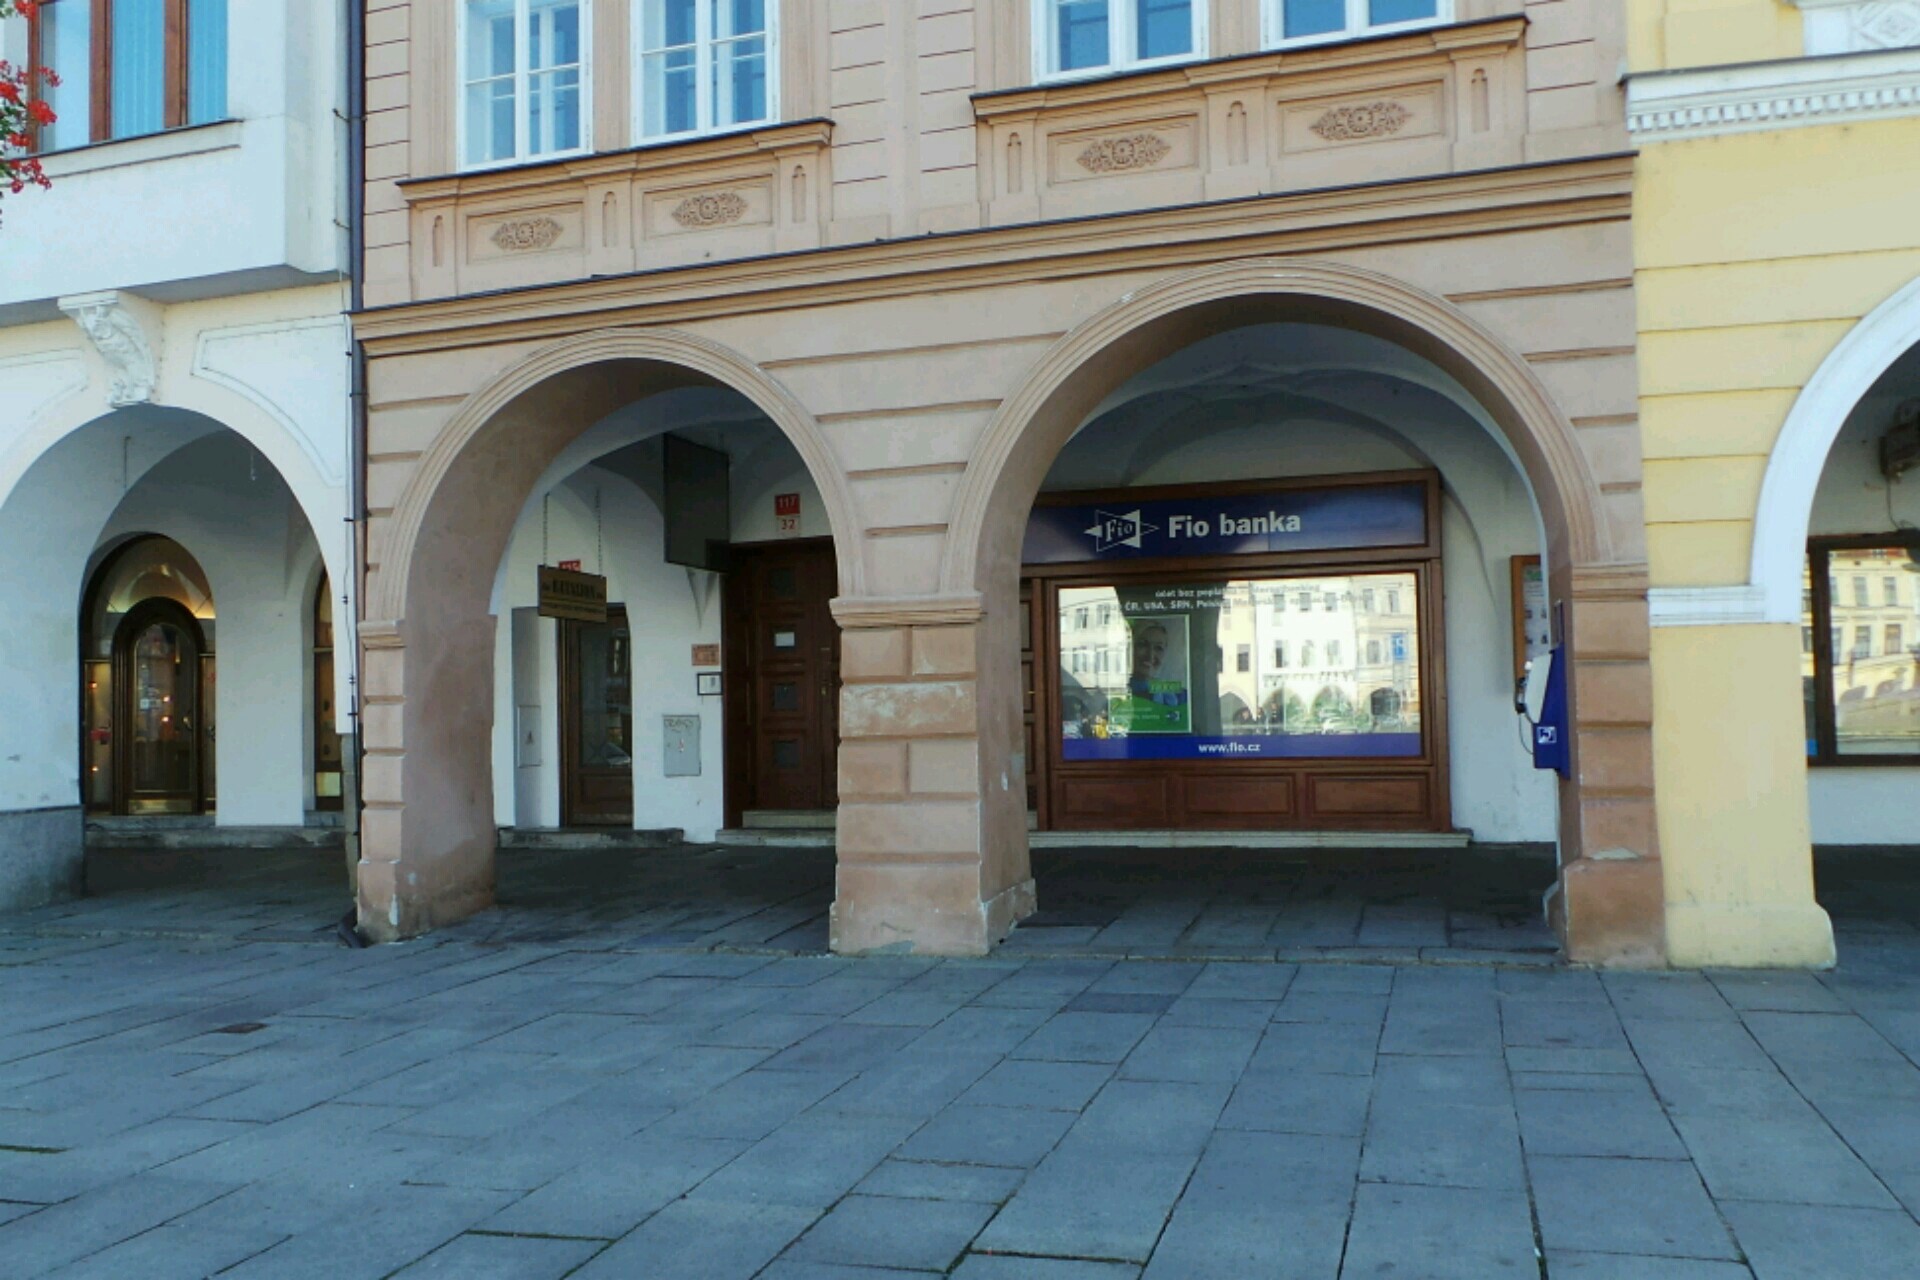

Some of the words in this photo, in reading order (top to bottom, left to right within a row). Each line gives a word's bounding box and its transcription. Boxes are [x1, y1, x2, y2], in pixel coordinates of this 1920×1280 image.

[1105, 518, 1133, 542] Fio
[1168, 515, 1210, 538] Fio
[1219, 511, 1301, 536] banka
